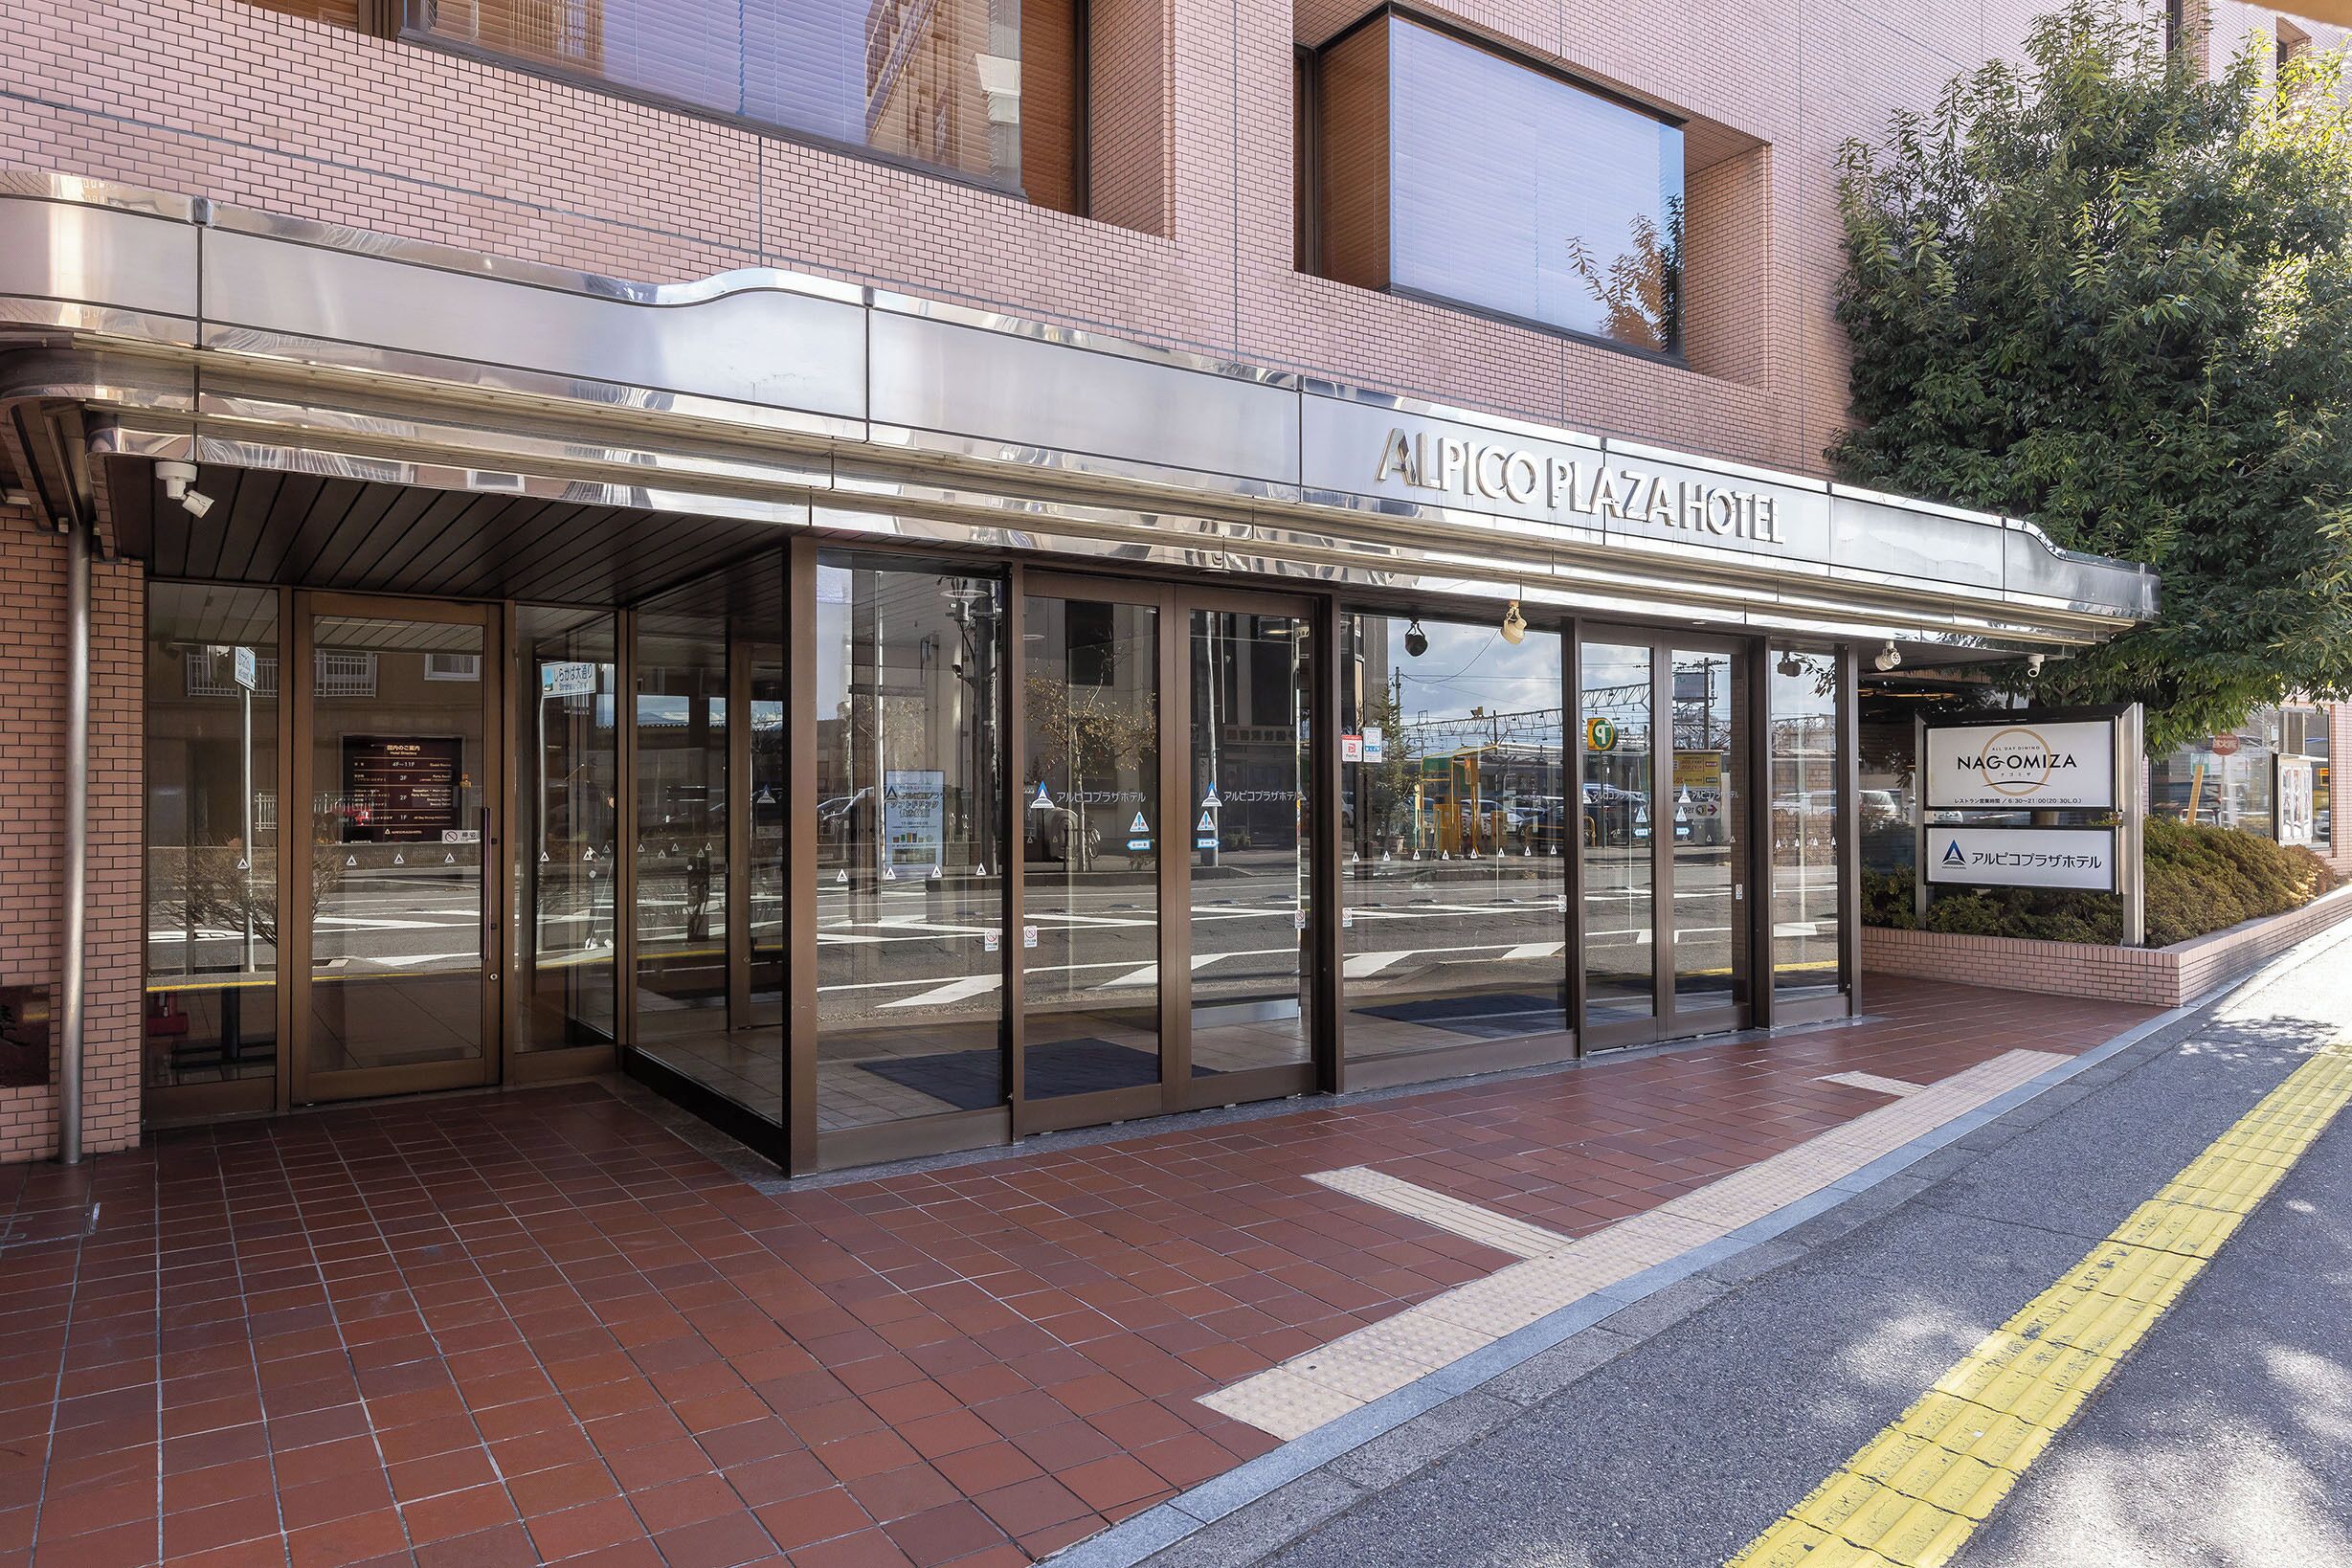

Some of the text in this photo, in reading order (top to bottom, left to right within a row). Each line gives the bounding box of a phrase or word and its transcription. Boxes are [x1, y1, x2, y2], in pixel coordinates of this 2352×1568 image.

[1375, 428, 1786, 544] ALPICO PLAZA HOTEL
[1958, 753, 2077, 770] NAGOMIZA
[1056, 791, 1146, 803] アルピコプラザホテル
[1971, 852, 2102, 869] アルピコプラザホテル
